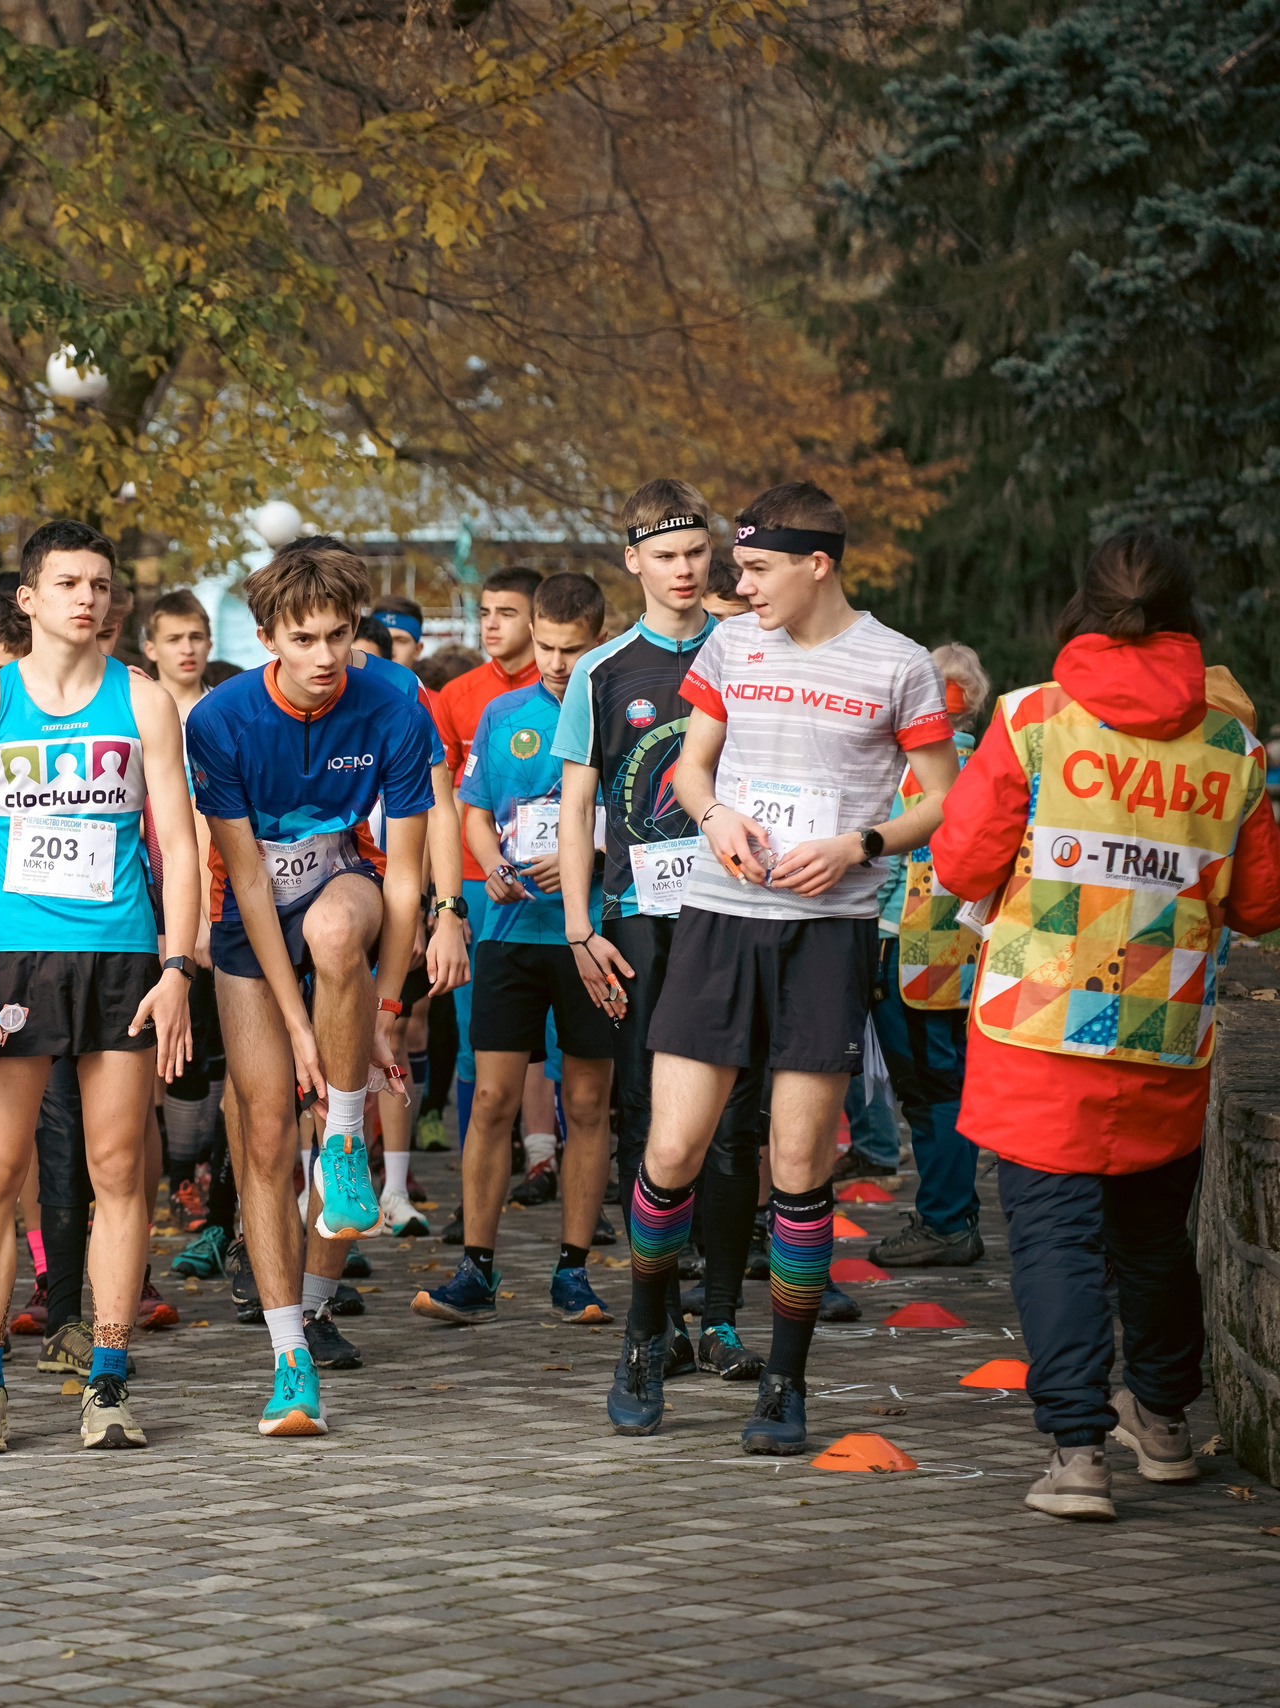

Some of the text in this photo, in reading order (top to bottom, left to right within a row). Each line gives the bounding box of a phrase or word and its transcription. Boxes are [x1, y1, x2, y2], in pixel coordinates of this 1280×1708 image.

[725, 683, 884, 720] NORD WEST
[41, 721, 89, 732] noname
[1062, 750, 1231, 820] СУДЬЯ
[5, 787, 126, 808] clockwork
[752, 799, 795, 827] 201
[26, 817, 82, 828] ПЕРВЕНСТВО РОССИИ
[808, 819, 815, 833] 1
[536, 822, 559, 840] 21
[30, 836, 79, 861] 203
[531, 841, 557, 849] МЖ16
[678, 839, 697, 847] РОССИИ
[23, 859, 55, 871] МЖ16
[89, 852, 95, 866] 1
[275, 851, 319, 877] 202
[271, 877, 302, 886] МЖ16
[652, 880, 683, 891] МЖ16
